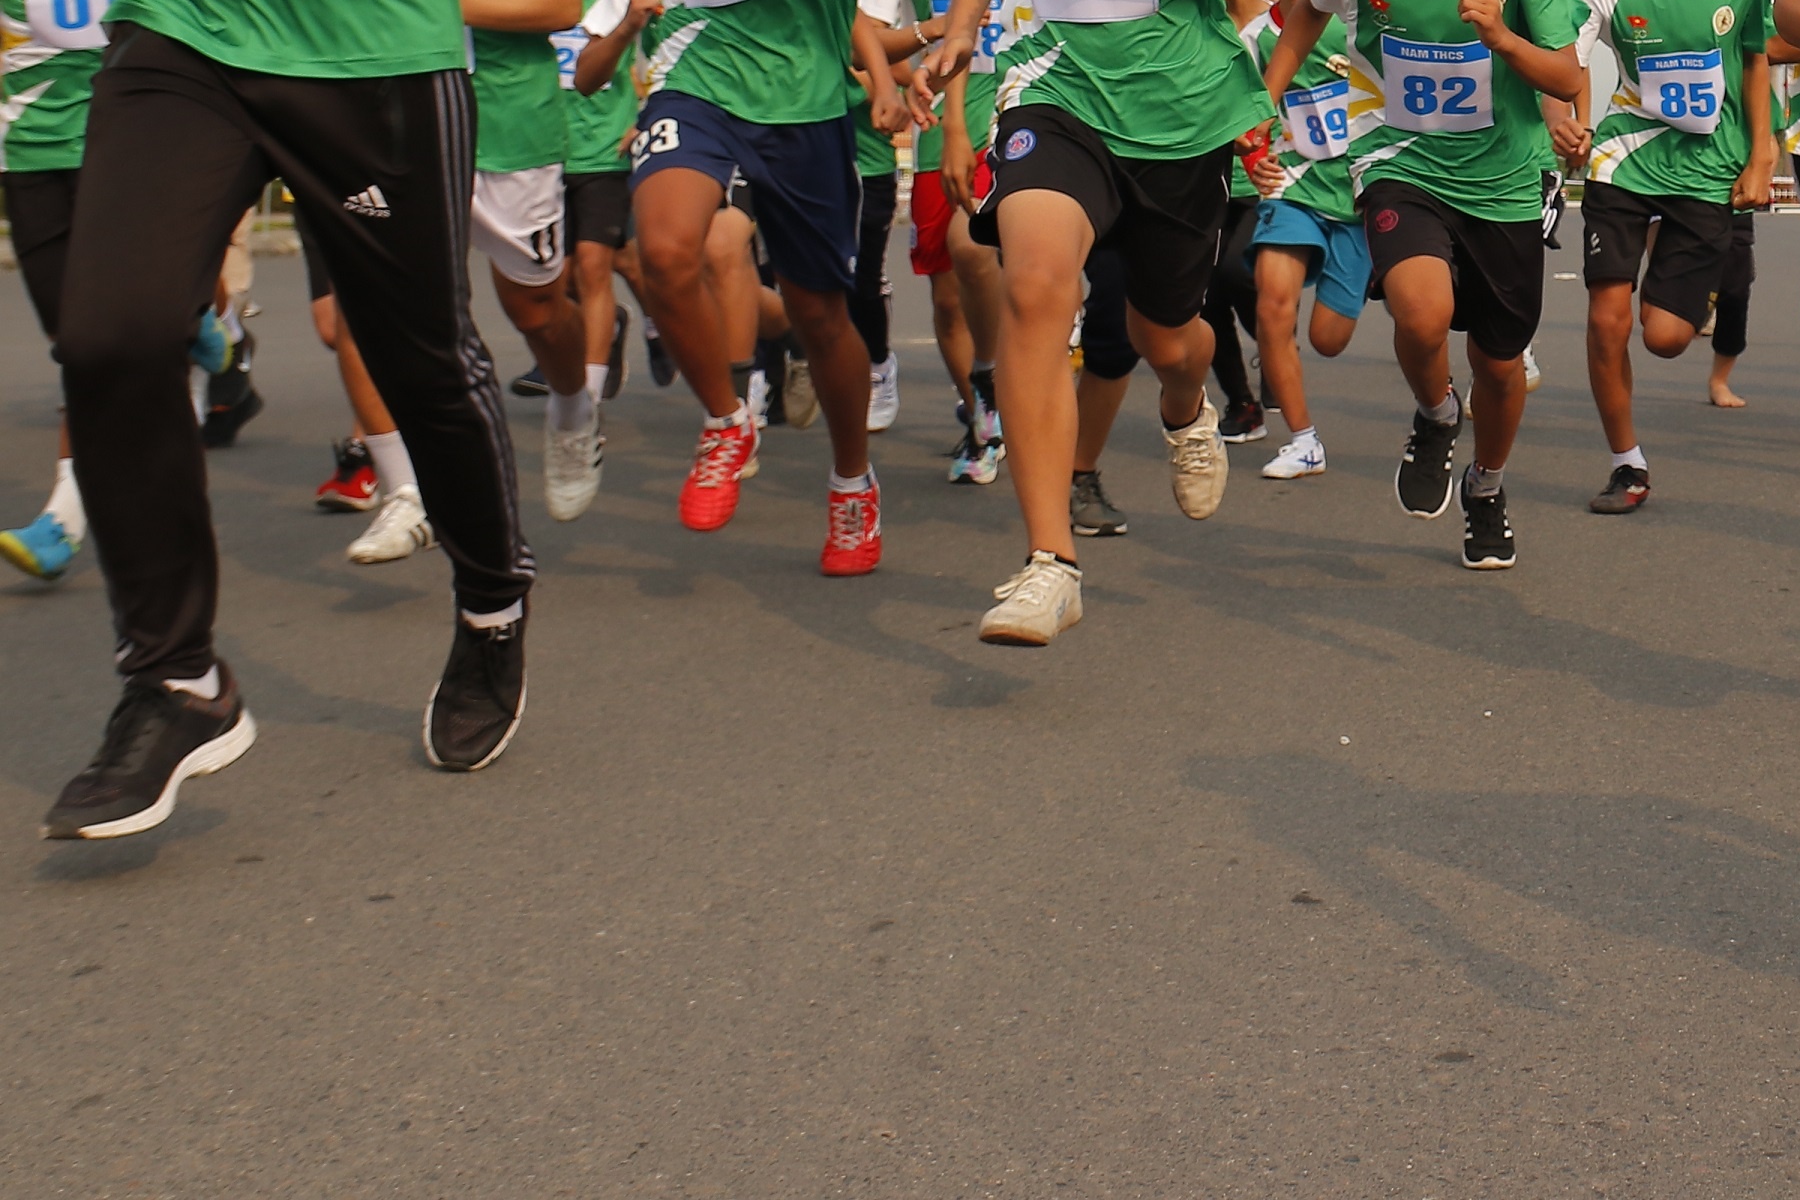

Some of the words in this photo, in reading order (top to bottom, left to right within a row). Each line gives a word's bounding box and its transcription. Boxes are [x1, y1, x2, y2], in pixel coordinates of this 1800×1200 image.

[972, 23, 1005, 57] 8
[1401, 47, 1429, 59] NAM
[1432, 50, 1465, 61] THCS
[1655, 61, 1679, 69] NAM
[1681, 59, 1705, 68] THCS
[1403, 75, 1477, 115] 82
[1660, 81, 1717, 118] 85
[630, 117, 681, 173] 23
[1306, 108, 1348, 146] 89
